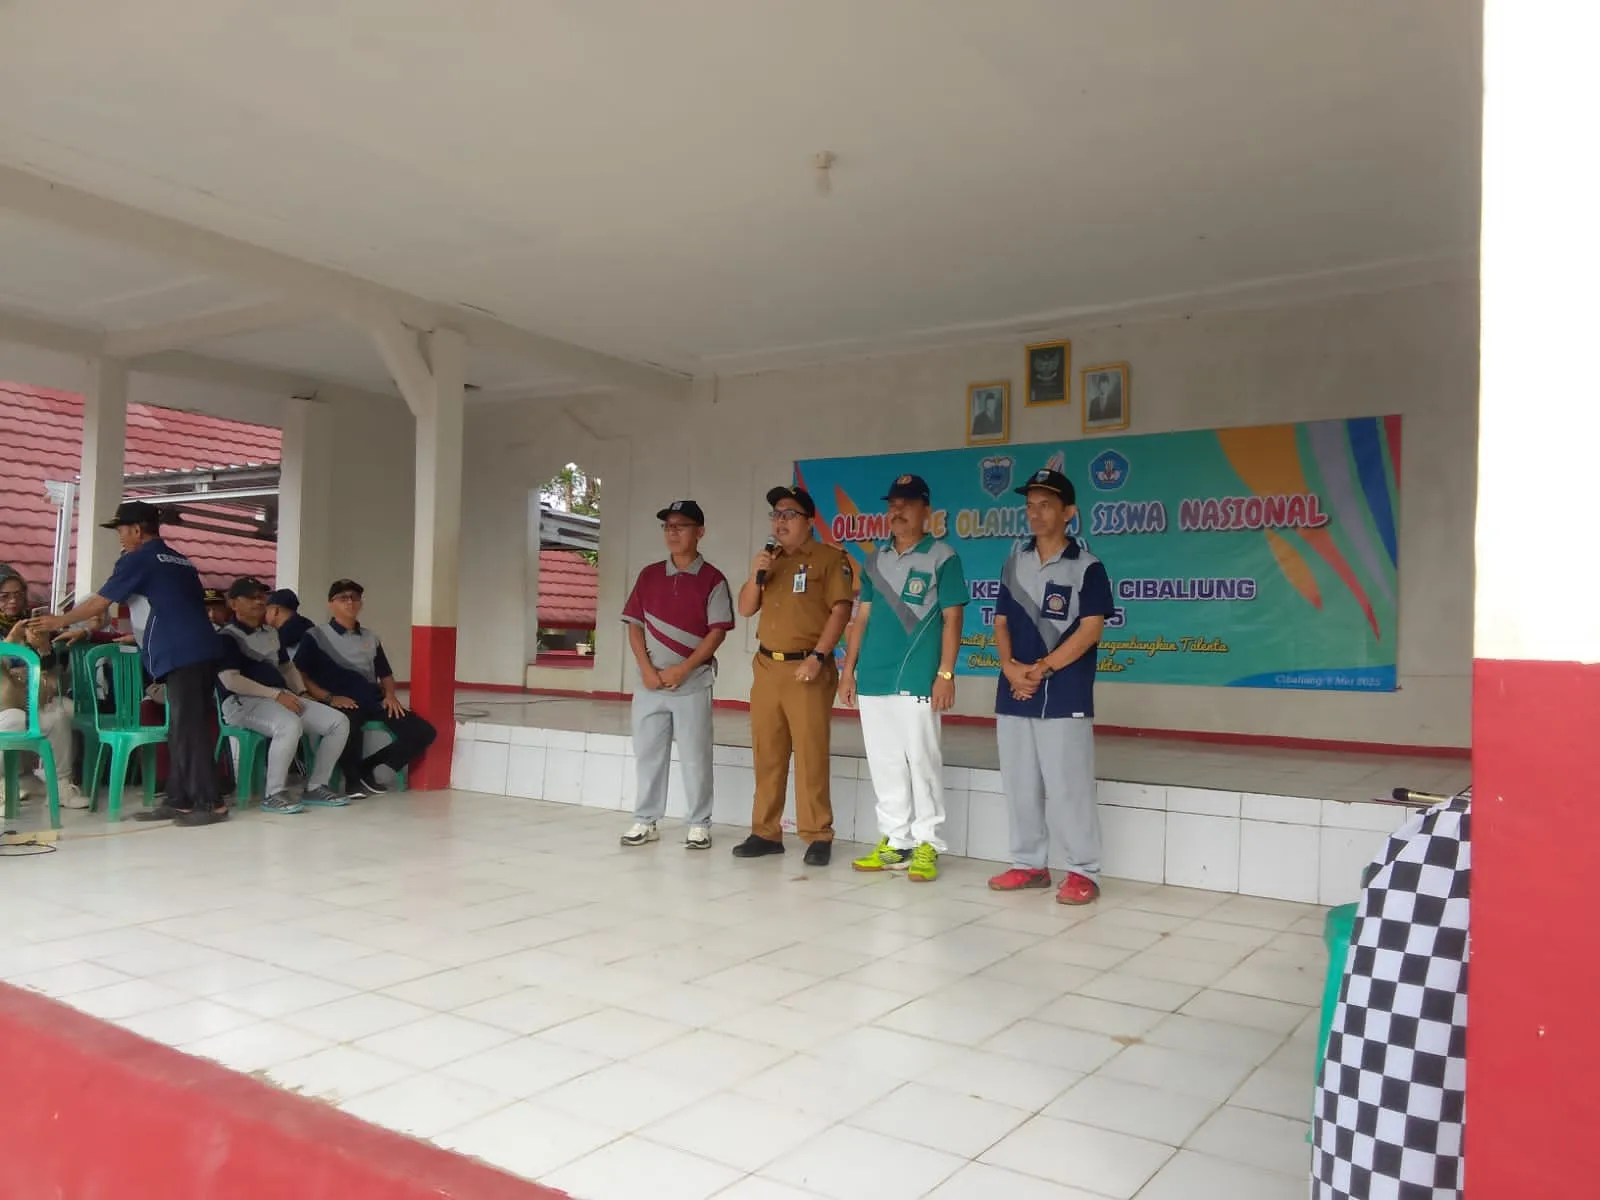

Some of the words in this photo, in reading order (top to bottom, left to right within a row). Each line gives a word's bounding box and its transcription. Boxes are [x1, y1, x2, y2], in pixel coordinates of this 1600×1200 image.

[832, 510, 947, 542] OLIME
[1091, 501, 1166, 534] SISWA
[1179, 493, 1328, 530] NASIONAL
[1119, 579, 1256, 600] CIBALIUNG
[1097, 634, 1177, 656] engembangkan
[1180, 636, 1229, 652] Talenta
